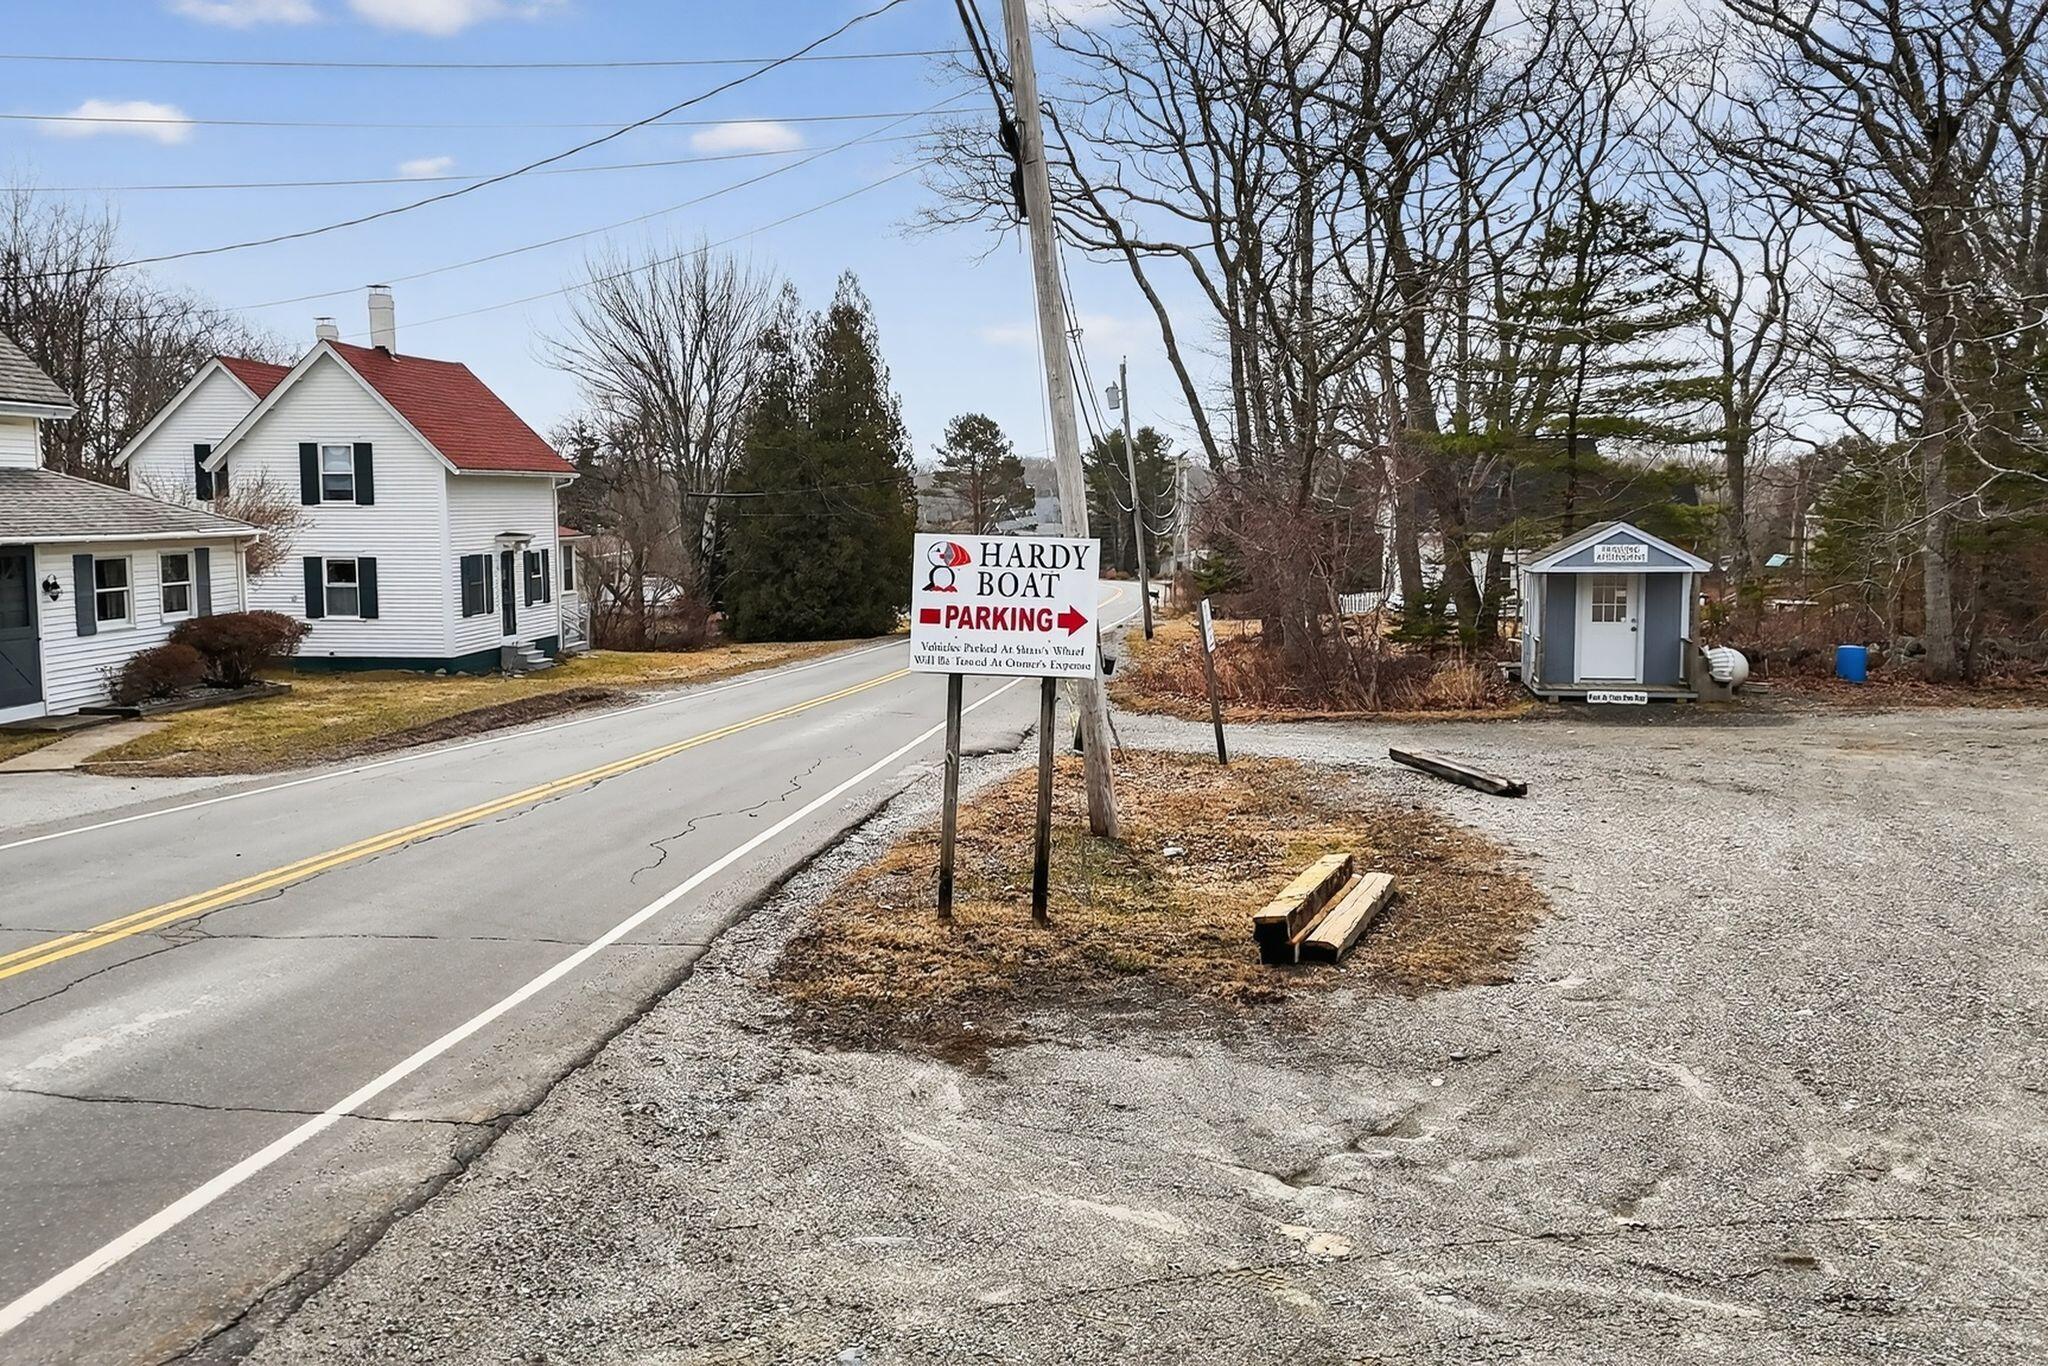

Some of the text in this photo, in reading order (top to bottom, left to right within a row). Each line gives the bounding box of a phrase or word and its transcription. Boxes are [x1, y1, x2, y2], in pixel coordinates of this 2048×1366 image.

[979, 542, 1090, 570] HARDY
[976, 571, 1060, 598] BOAT
[945, 605, 1053, 632] PARKING
[914, 655, 935, 665] Will
